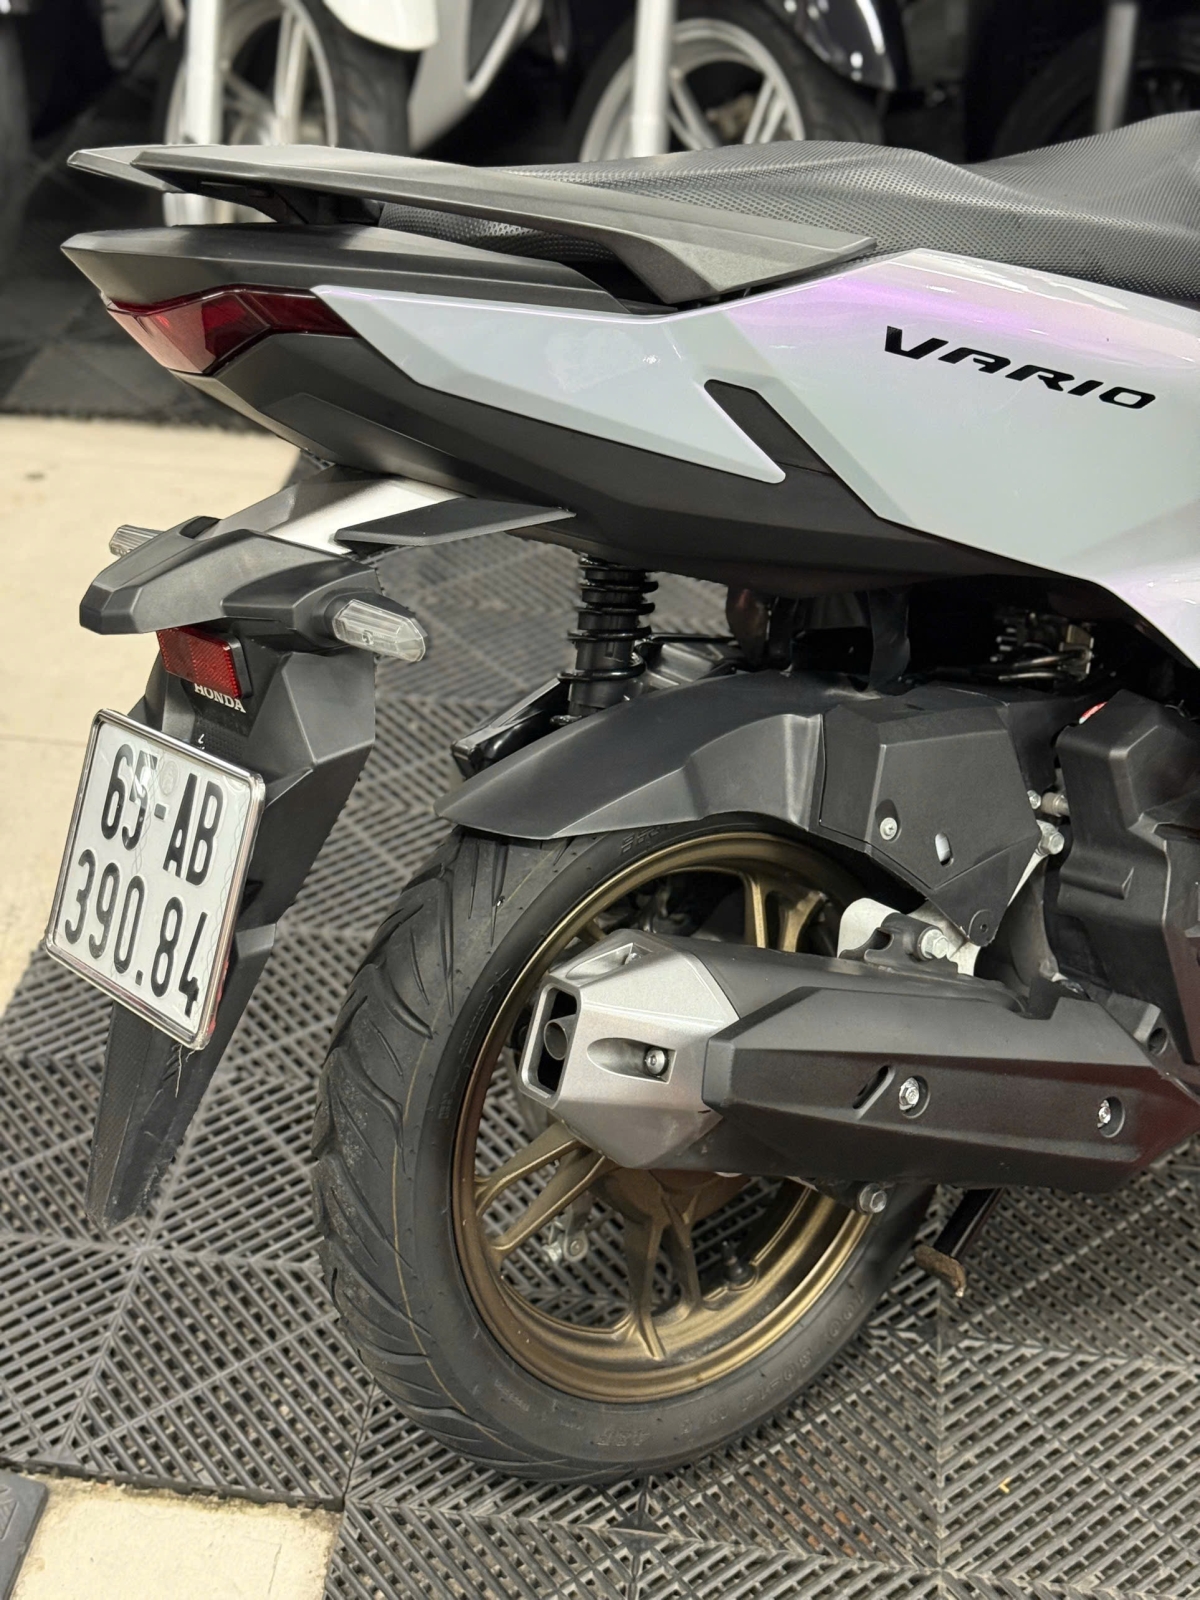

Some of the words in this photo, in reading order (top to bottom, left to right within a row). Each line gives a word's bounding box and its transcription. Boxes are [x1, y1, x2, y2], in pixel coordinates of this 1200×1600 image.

[884, 325, 1156, 409] VARIO
[194, 683, 246, 713] HONDA
[65, 848, 209, 1019] 390.84
